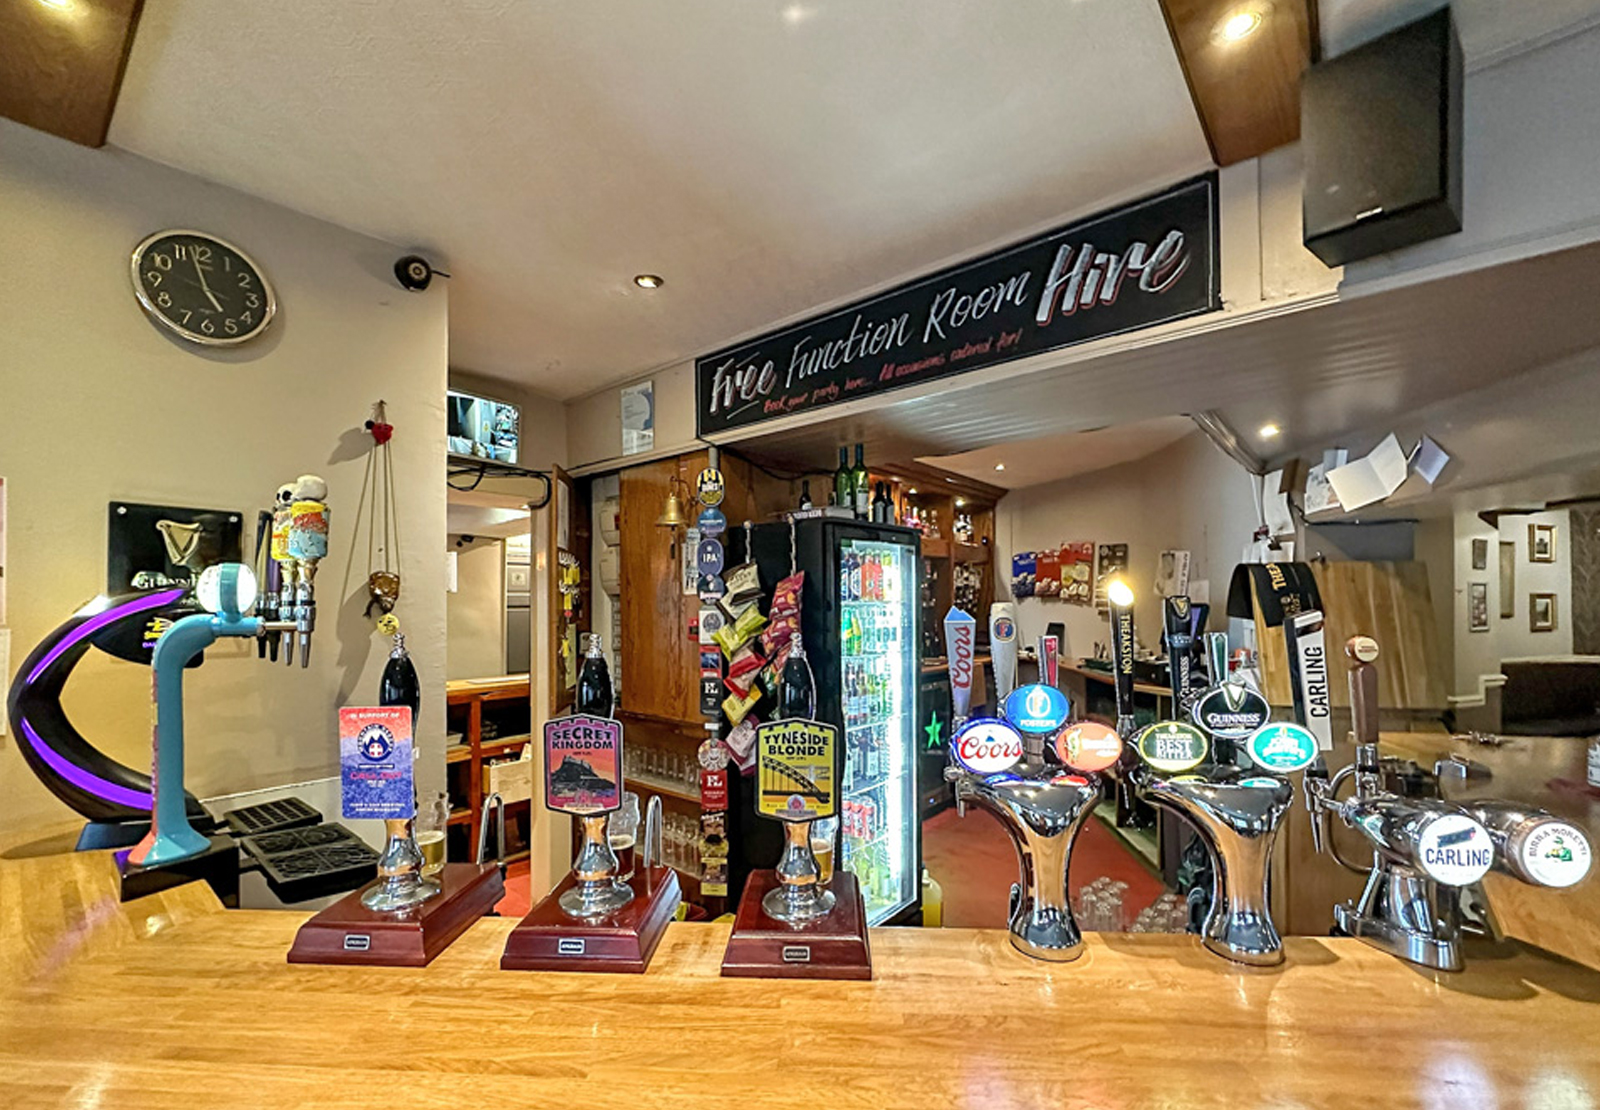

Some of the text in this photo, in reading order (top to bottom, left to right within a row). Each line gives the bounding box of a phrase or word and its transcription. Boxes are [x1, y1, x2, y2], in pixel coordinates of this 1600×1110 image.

[173, 243, 187, 261] 11
[193, 244, 213, 264] 12
[151, 251, 172, 271] 10
[223, 255, 231, 272] 1
[147, 270, 162, 288] 9
[237, 271, 250, 288] 2
[157, 291, 172, 308] 8
[244, 292, 259, 308] 3
[179, 308, 193, 325] 7
[239, 311, 252, 325] 4
[709, 229, 1193, 416] Free Function Room Hire
[200, 318, 215, 334] 6
[224, 318, 238, 334] 5
[702, 553, 718, 563] IPA
[1119, 614, 1133, 675] THEAKSTON
[952, 624, 972, 690] Coors
[1304, 646, 1329, 718] CARLING
[1207, 713, 1261, 724] GUINNESS
[552, 726, 613, 740] SECRET
[763, 730, 829, 746] TYNESIDE
[552, 740, 614, 750] KINGDOM
[768, 745, 825, 756] BLONDE
[957, 736, 1024, 760] Coors
[1156, 739, 1193, 751] BEST
[1156, 750, 1193, 760] BITTER
[1528, 828, 1587, 857] BIRRA MORETTI
